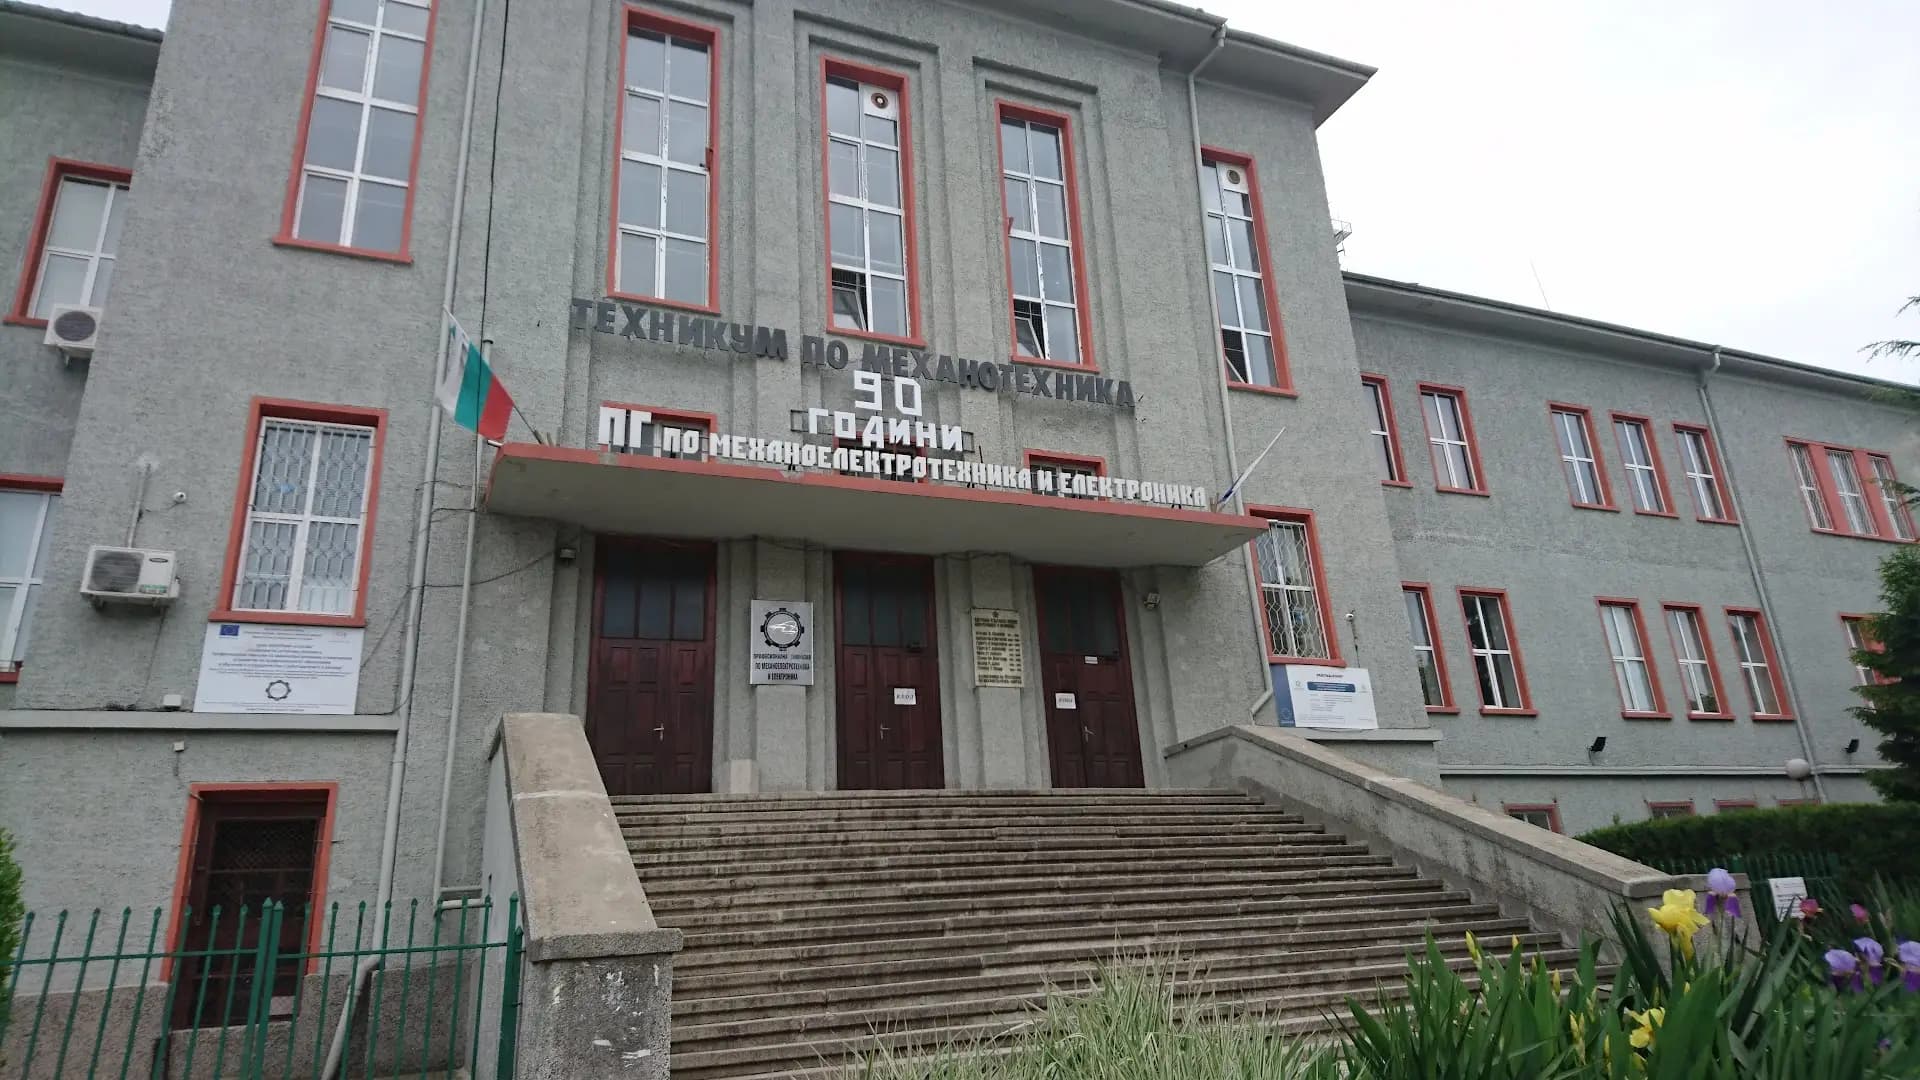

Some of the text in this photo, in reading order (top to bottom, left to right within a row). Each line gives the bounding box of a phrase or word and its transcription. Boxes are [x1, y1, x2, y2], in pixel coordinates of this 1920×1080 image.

[571, 300, 1136, 407] ТЕХНИКУМ ПО МЕХАНОТЕХНИКА
[808, 407, 963, 451] ГОДИНИ
[853, 370, 922, 417] 90
[597, 406, 1206, 507] ПГ ПО МЕХАНОЕЛЕКТРОТЕХНИКА И ЕЛЕКТРОНИКА
